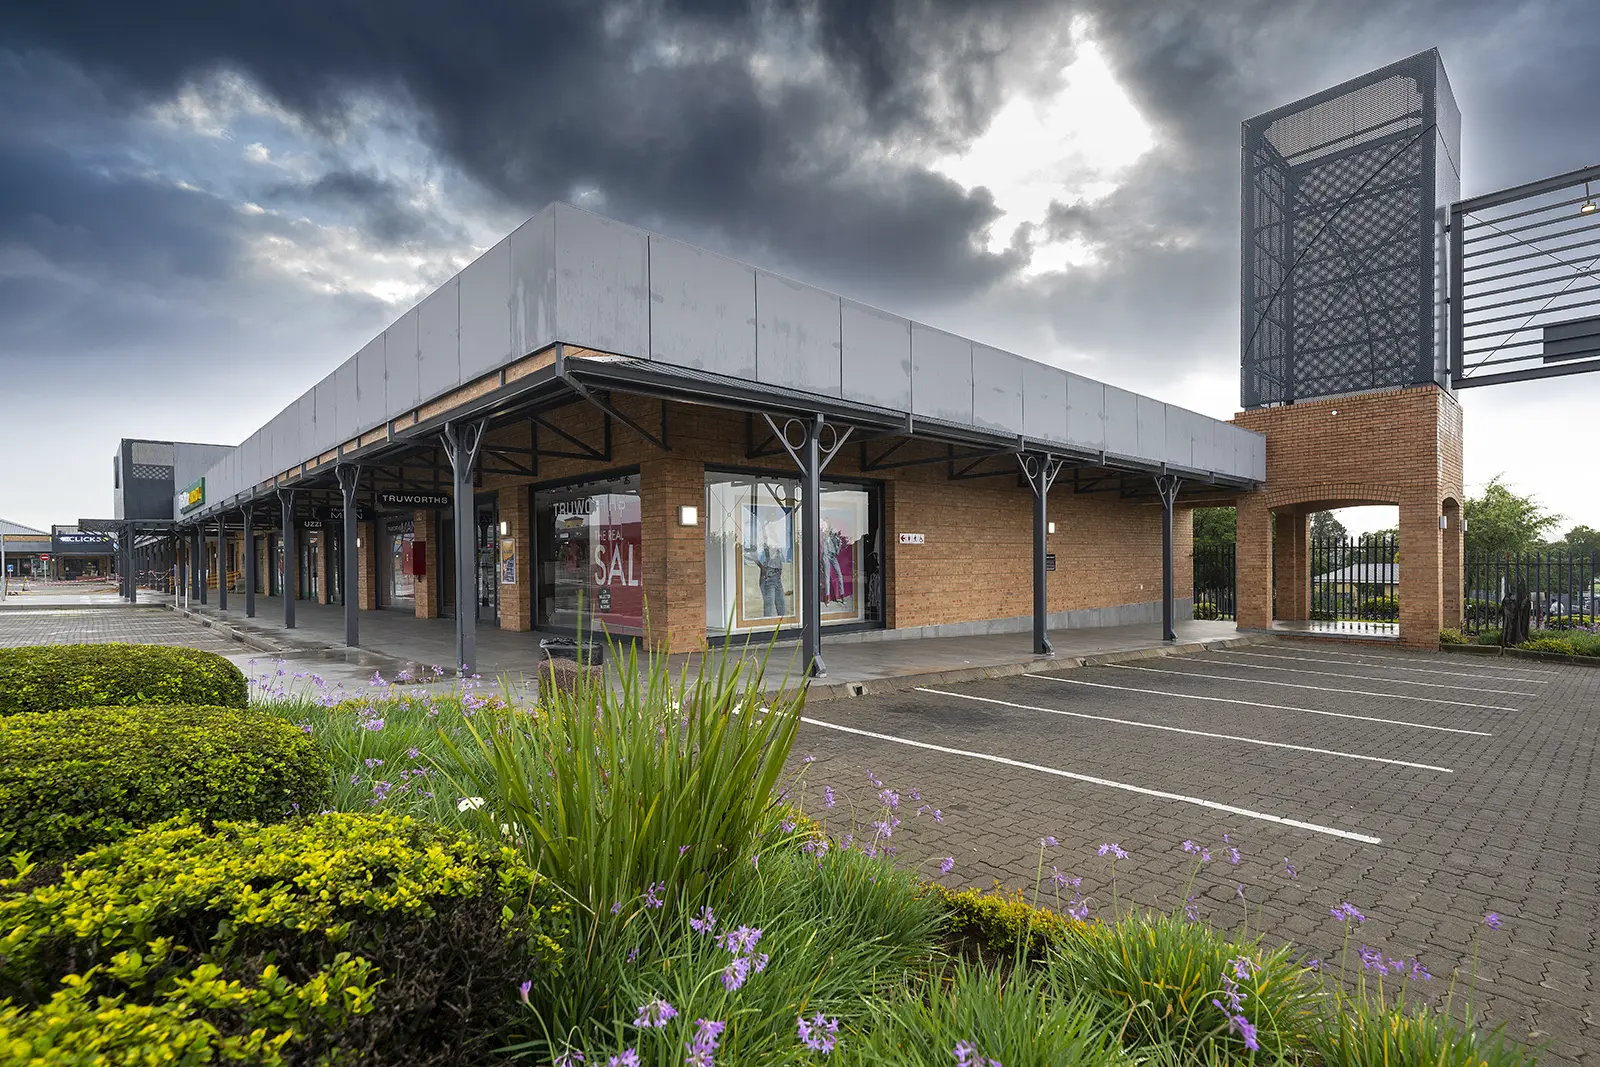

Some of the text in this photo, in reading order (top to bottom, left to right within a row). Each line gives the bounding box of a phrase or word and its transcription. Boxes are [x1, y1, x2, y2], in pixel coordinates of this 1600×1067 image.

[382, 494, 448, 504] TRUWORTHS
[331, 512, 363, 520] MN
[594, 529, 625, 541] THE REAL
[594, 543, 642, 587] SAL
